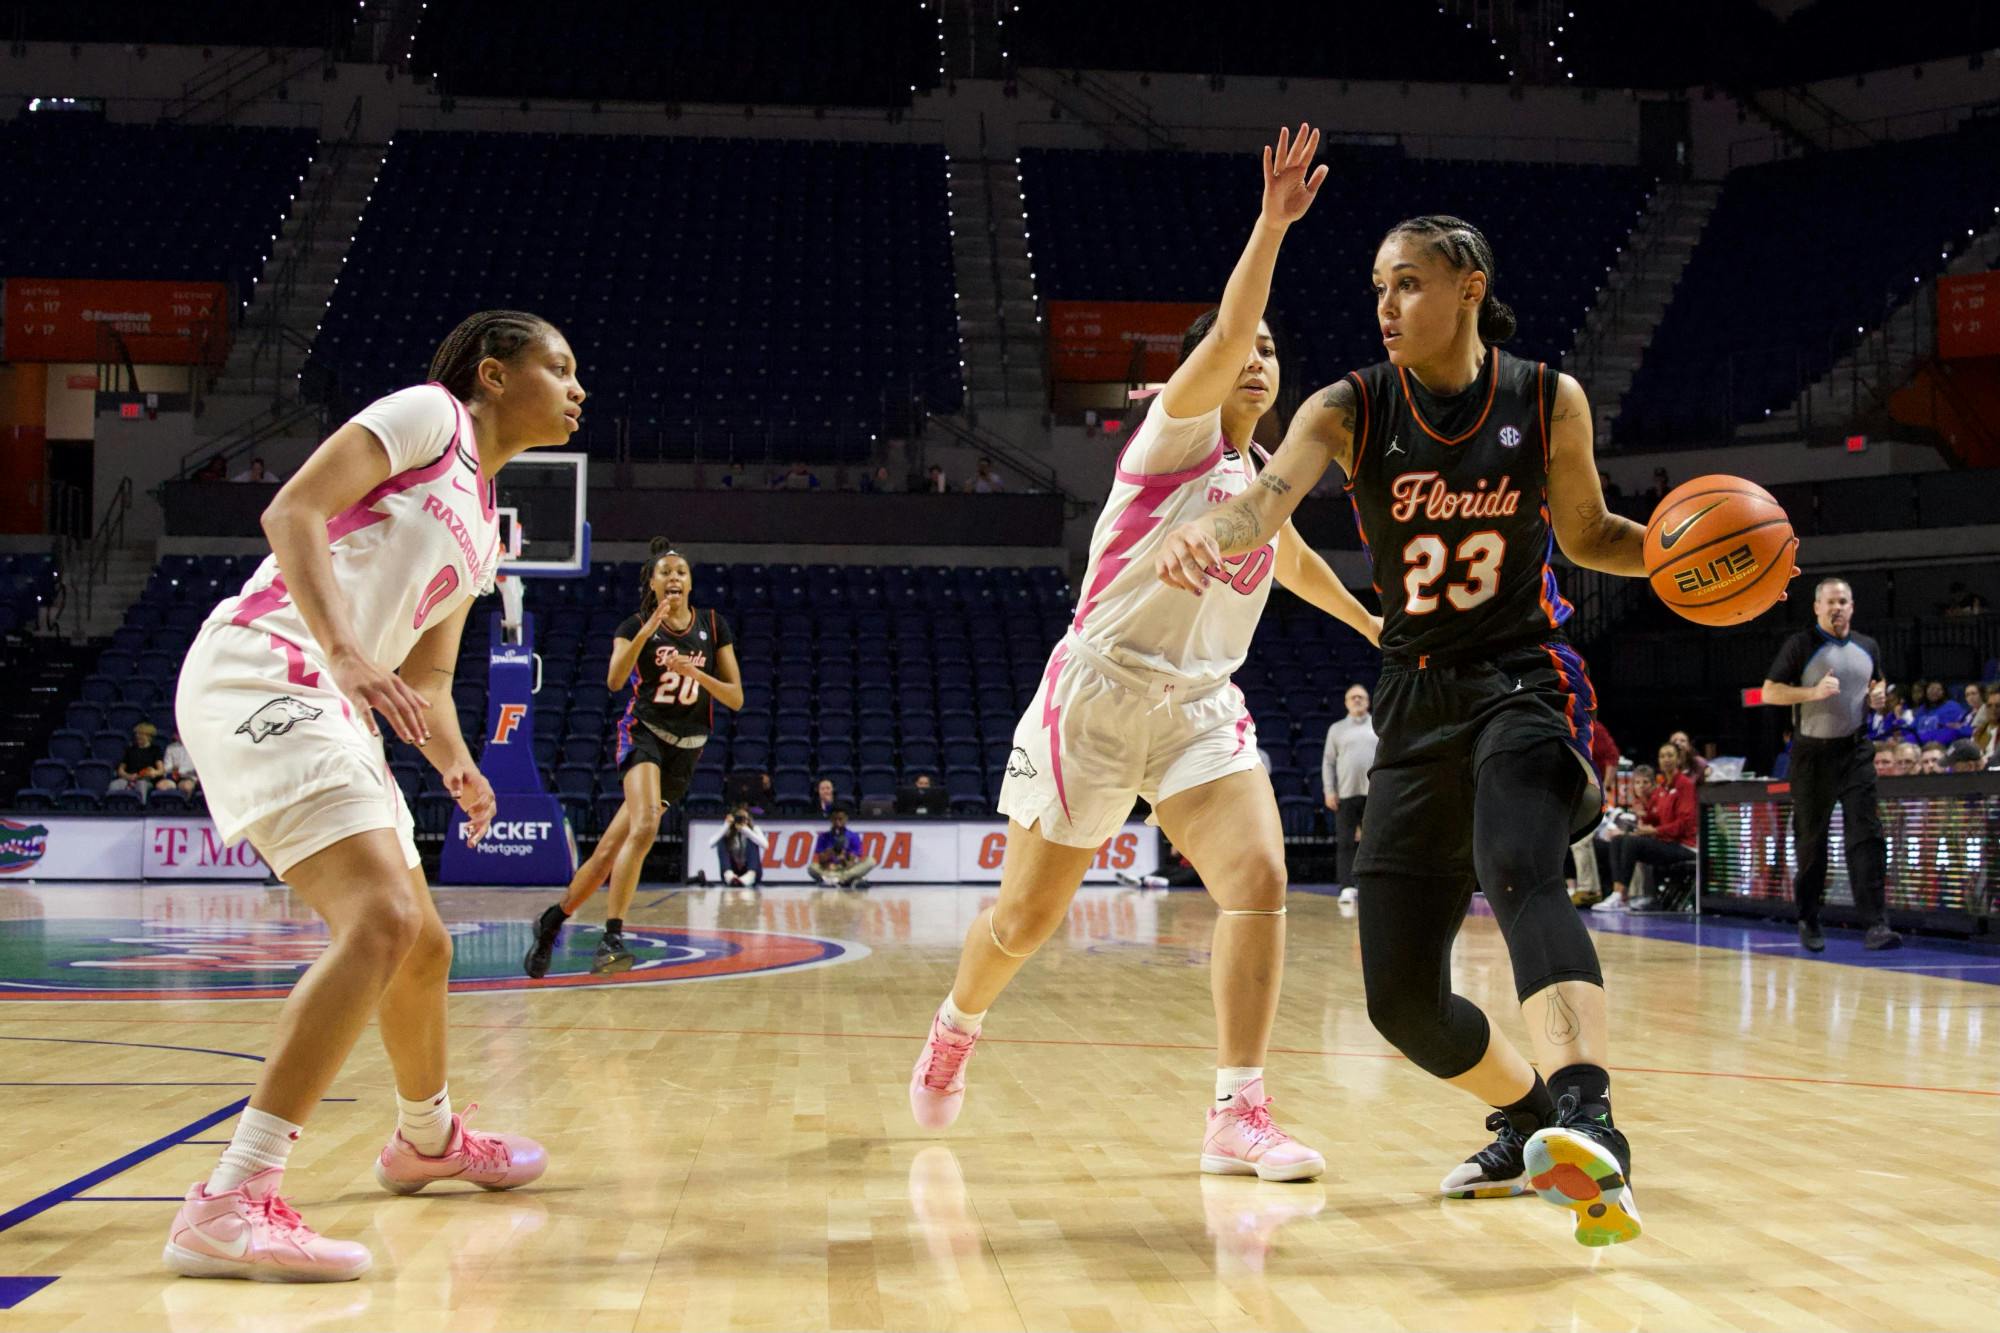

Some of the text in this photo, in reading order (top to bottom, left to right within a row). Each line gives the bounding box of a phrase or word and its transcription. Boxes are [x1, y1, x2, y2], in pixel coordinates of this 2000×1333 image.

[113, 322, 152, 334] RENA
[1500, 427, 1521, 447] SEC
[1391, 471, 1521, 523] Florida
[1403, 530, 1506, 615] 23
[1674, 544, 1756, 594] ELITE
[414, 565, 459, 630] 0
[653, 672, 700, 705] 20
[490, 704, 528, 744] F
[477, 842, 534, 857] Mortgage
[762, 831, 913, 869] LODA
